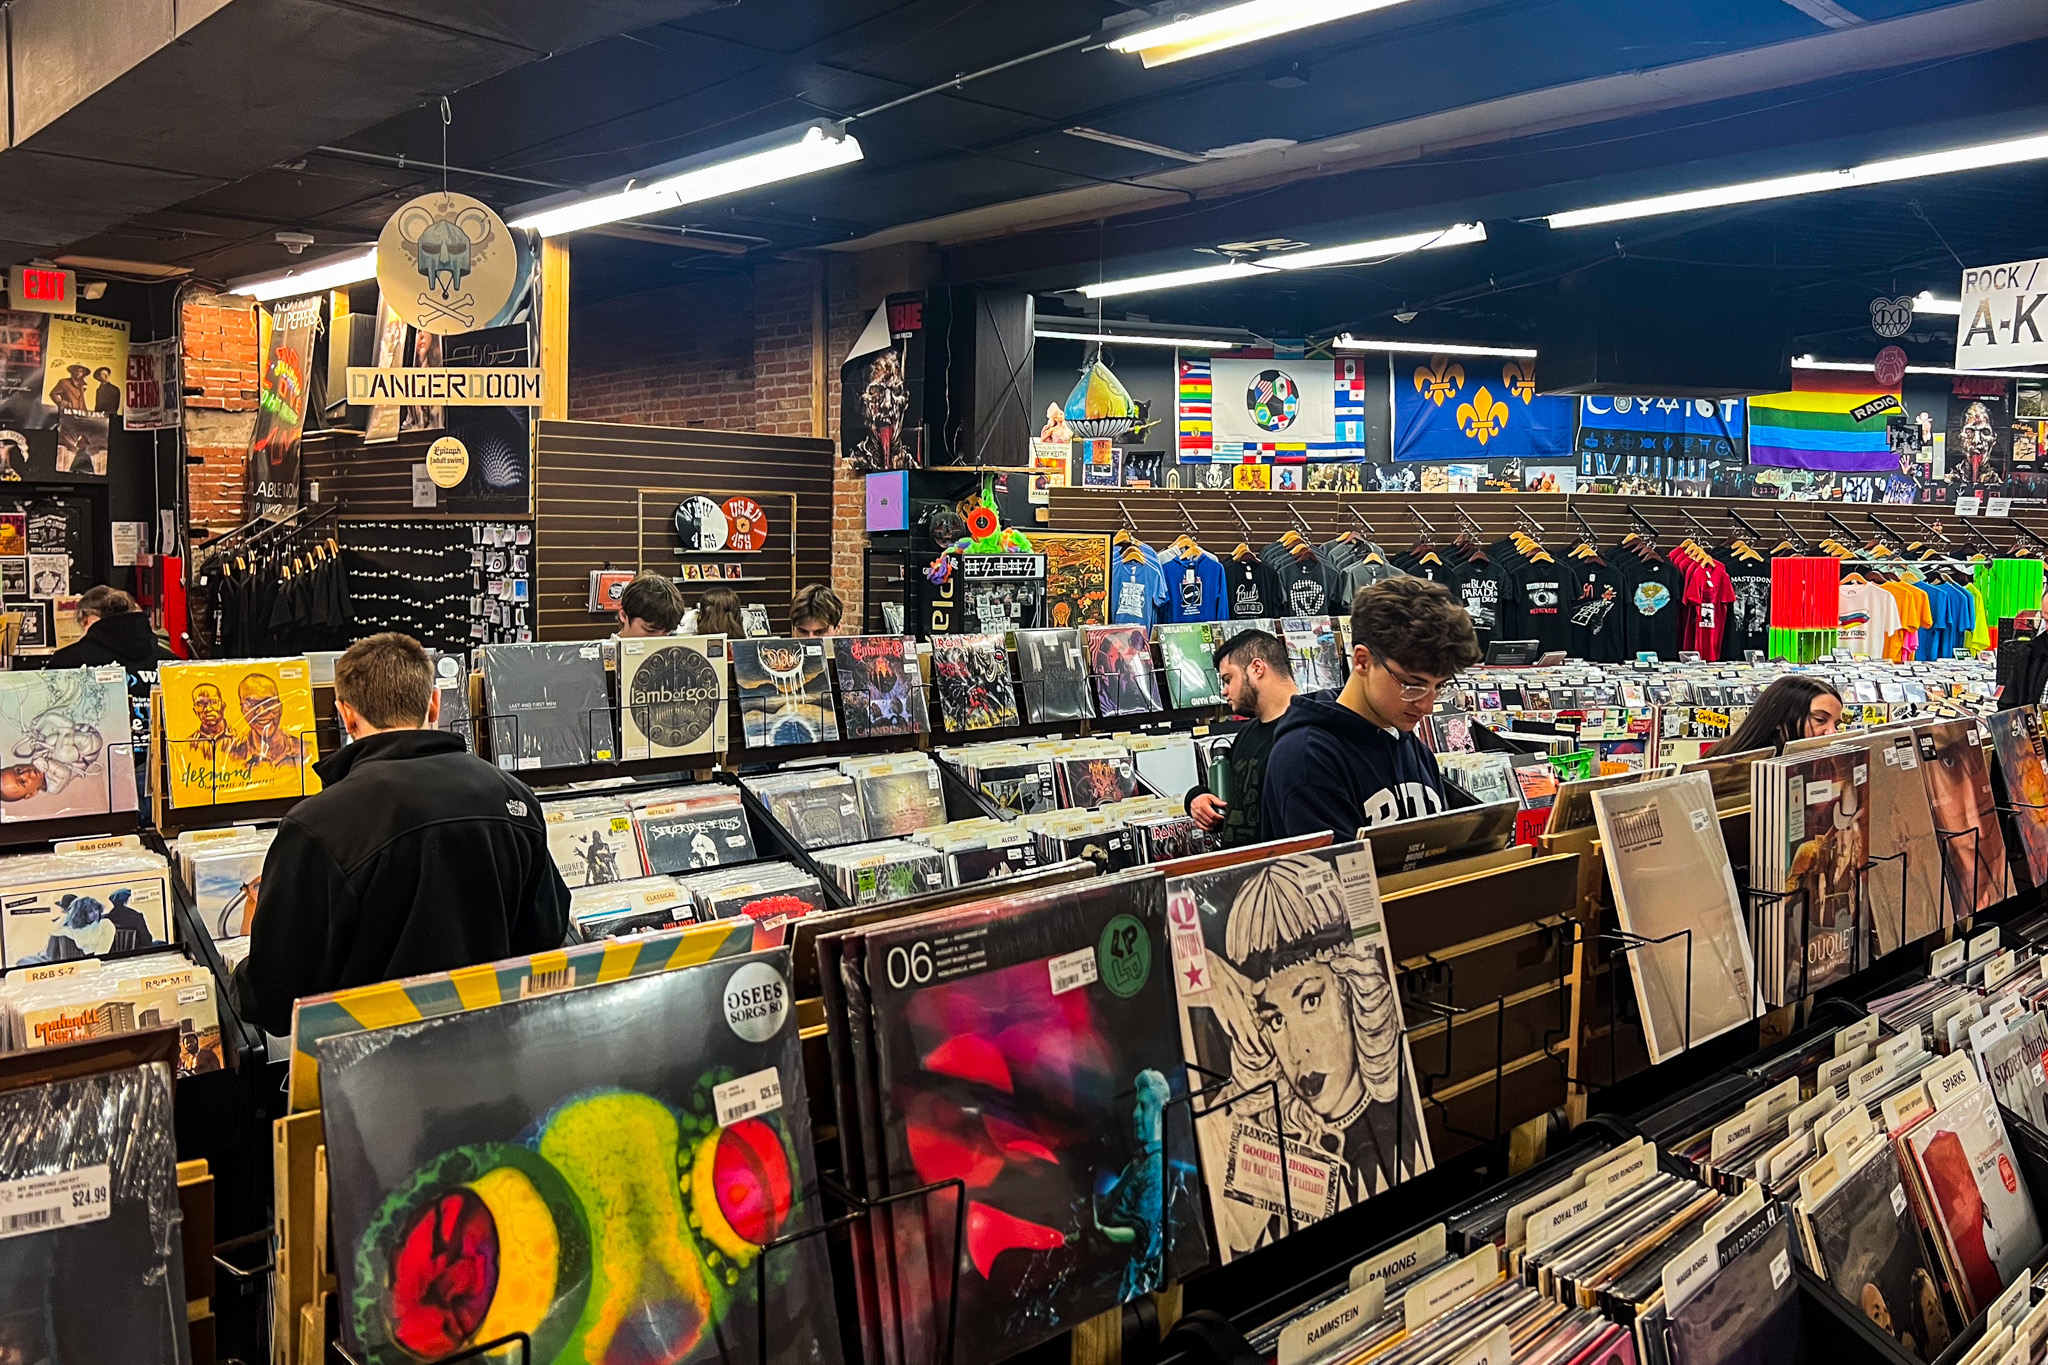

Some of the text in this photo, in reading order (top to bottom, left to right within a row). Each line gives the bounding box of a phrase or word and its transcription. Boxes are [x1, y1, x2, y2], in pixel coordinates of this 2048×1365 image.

[23, 268, 67, 303] EXIT
[1965, 265, 2021, 294] ROCK
[54, 313, 126, 332] BLACK PUMAS
[1961, 293, 2048, 347] A-K
[352, 372, 541, 399] DANGERDOOM
[1050, 450, 1067, 458] KEITH
[680, 502, 713, 521] NEW
[729, 499, 763, 522] USED
[1470, 578, 1498, 590] BLACK
[1730, 575, 1771, 584] MASTODON
[1461, 588, 1494, 599] PARADE
[1163, 625, 1193, 634] NEGATIVE
[933, 635, 963, 649] IRON
[631, 685, 720, 706] lamb of god
[1151, 825, 1175, 842] IRON
[79, 840, 123, 851] R&B COMPS
[646, 891, 676, 902] CLASSICAL
[1170, 896, 1196, 930] Q
[1800, 927, 1857, 968] OUQUET
[32, 966, 75, 981] R&B S-Z
[887, 941, 933, 989] 06
[170, 975, 193, 985] M-R
[727, 981, 783, 1009] OSEES
[769, 1000, 783, 1014] 80
[1829, 1060, 1852, 1078] STEREOLAB
[1860, 1064, 1884, 1085] STEELY DAN
[1941, 1069, 1967, 1093] SPARKS
[1726, 1124, 1751, 1145] SLOWDIVE
[1242, 1142, 1326, 1180] GOODBY HORSES
[1253, 1162, 1267, 1176] MANY
[1607, 1159, 1644, 1185] TODD RUNDGREN
[28, 1181, 57, 1190] MORNING
[58, 1176, 79, 1185] JACKET
[72, 1186, 107, 1208] $24.99
[1552, 1198, 1589, 1227] ROYAL TRUX
[1369, 1251, 1417, 1282] RAMONES
[1675, 1253, 1709, 1287] MAGGIE ROGERS
[1306, 1304, 1359, 1346] RAMMSTEIN
